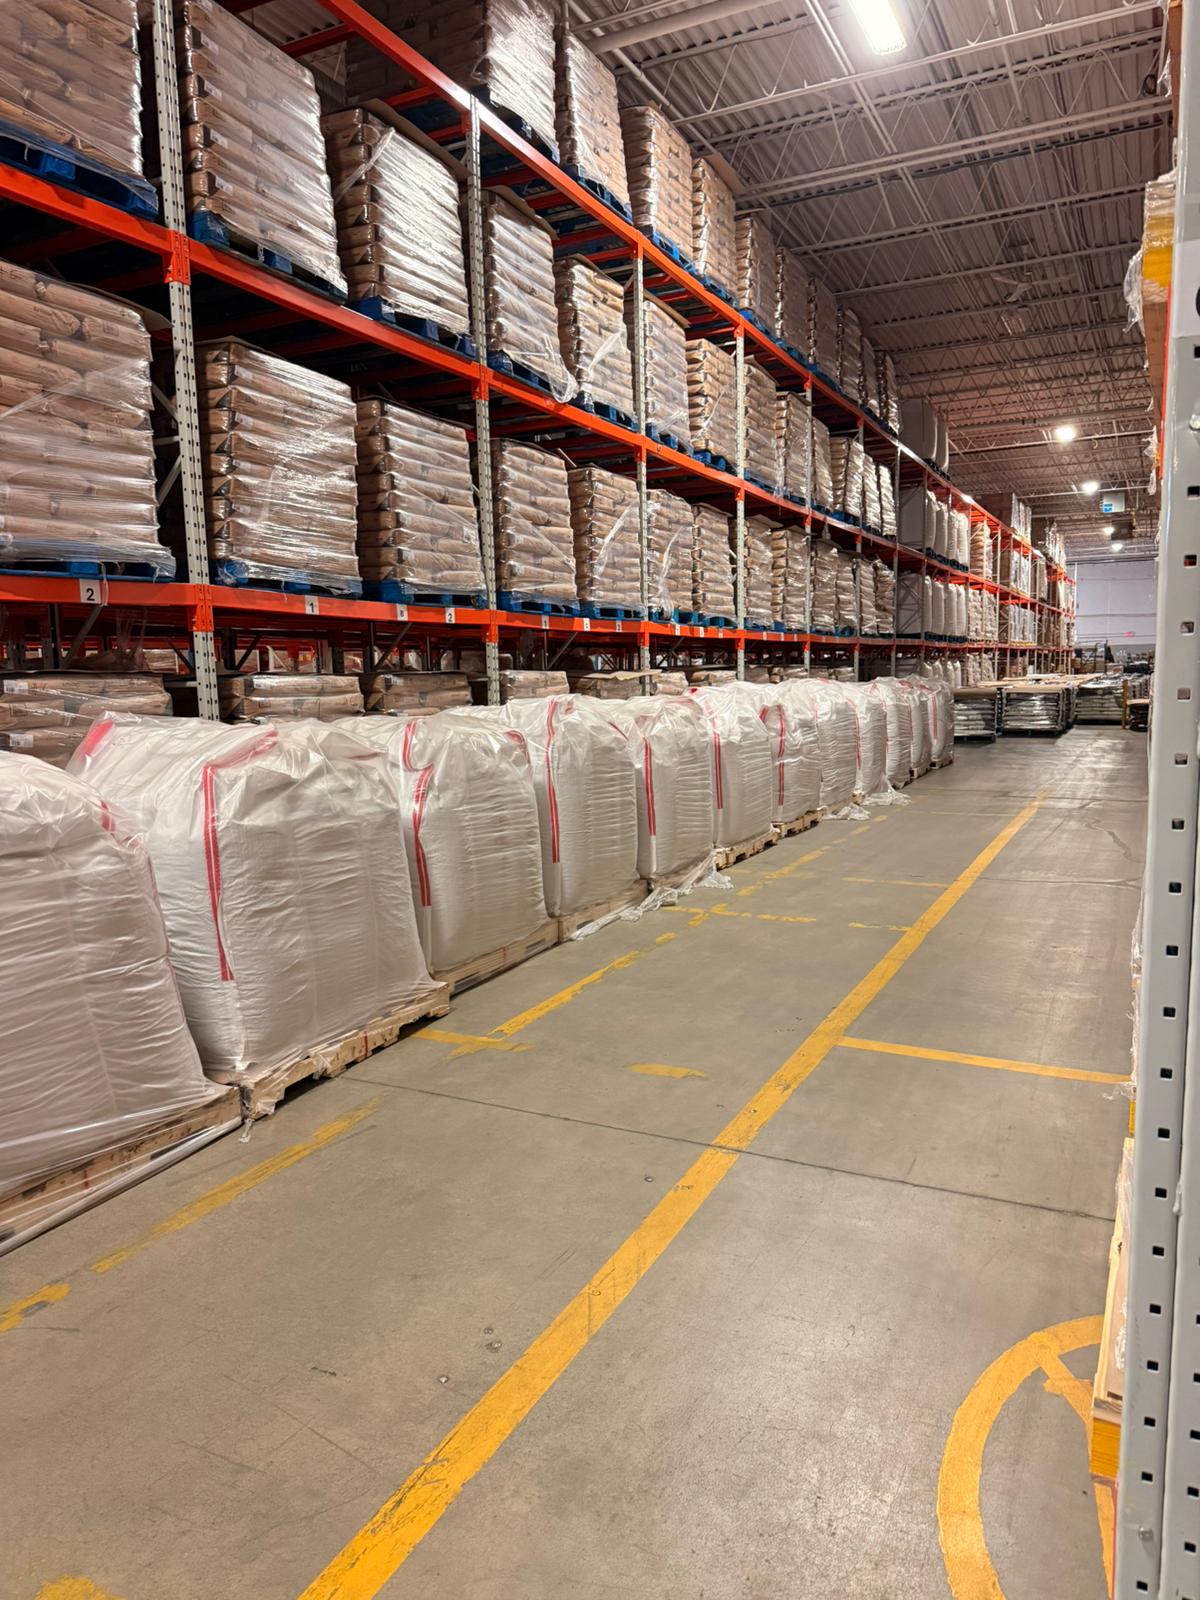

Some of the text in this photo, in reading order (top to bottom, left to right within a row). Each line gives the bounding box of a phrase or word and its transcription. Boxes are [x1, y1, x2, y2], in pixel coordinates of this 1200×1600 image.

[86, 588, 95, 601] 2
[310, 603, 315, 613] 1
[448, 613, 453, 622] 2
